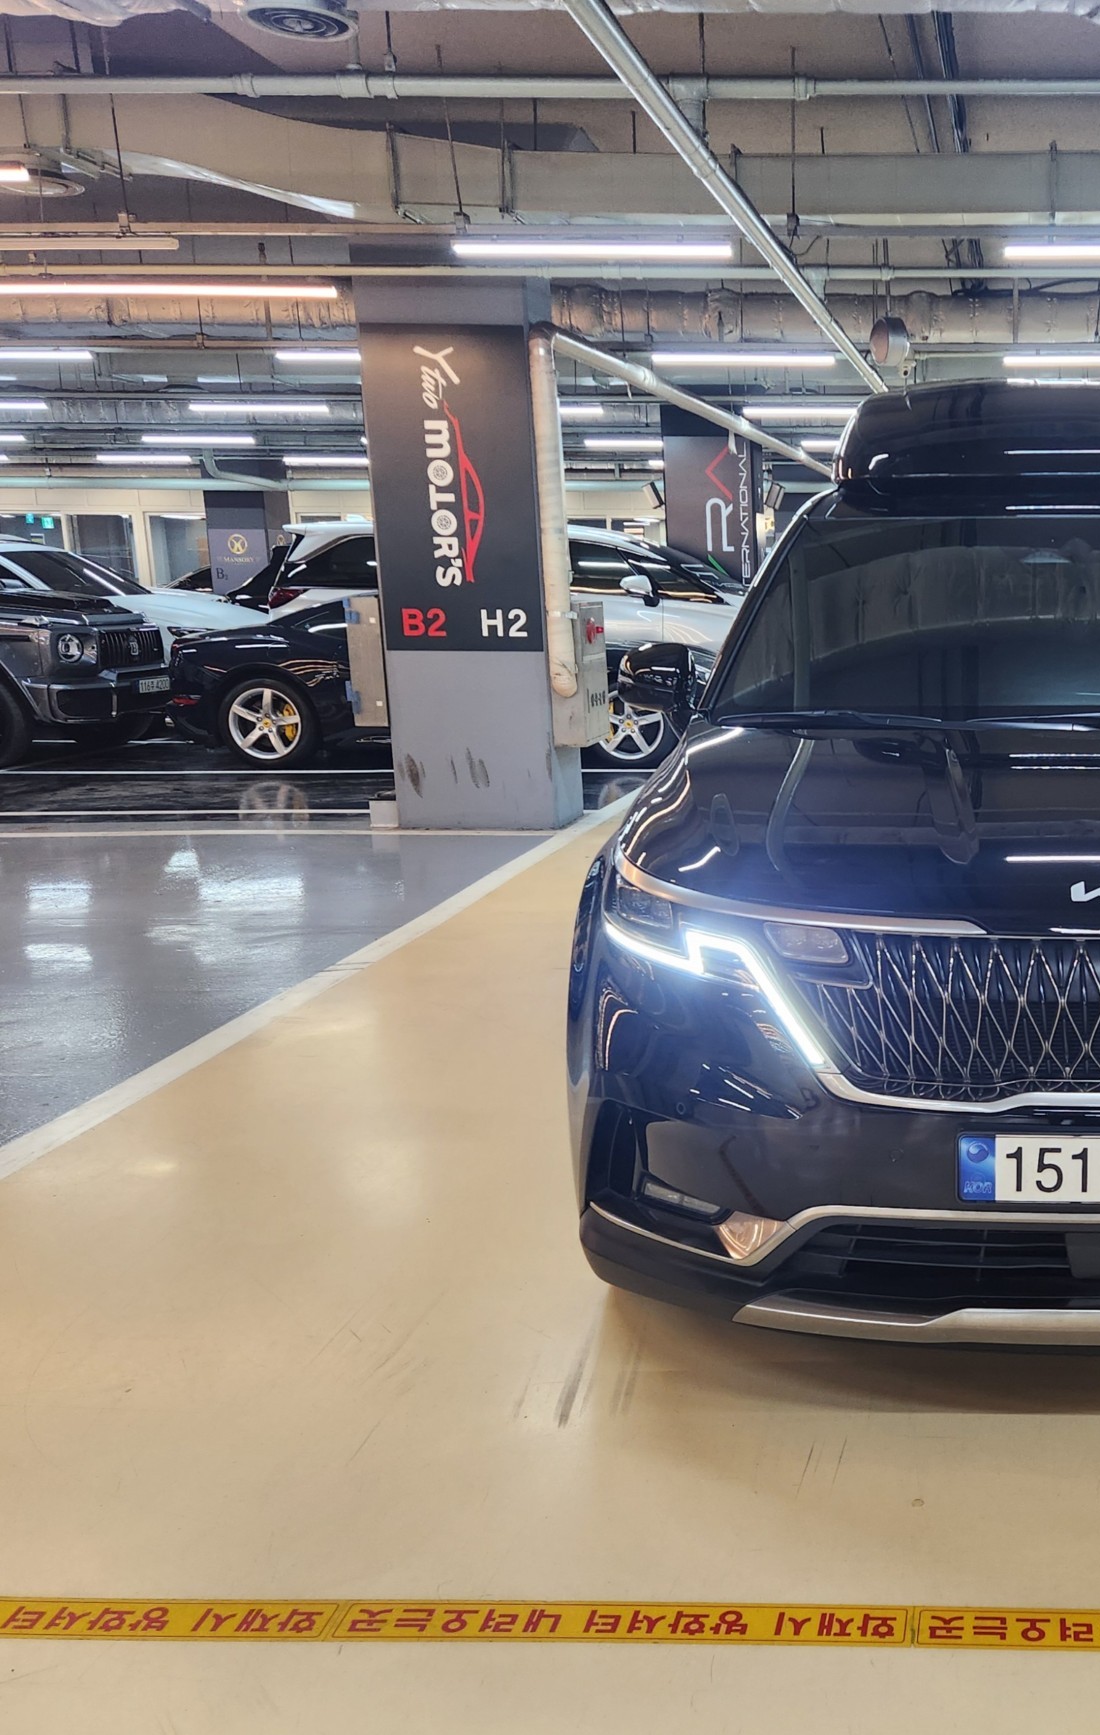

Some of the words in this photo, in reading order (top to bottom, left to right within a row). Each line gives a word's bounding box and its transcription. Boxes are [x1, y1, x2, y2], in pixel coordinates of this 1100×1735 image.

[401, 608, 447, 637] B2
[480, 608, 528, 638] H2
[0, 1606, 170, 1632] 방화셔터
[190, 1608, 324, 1634] 화재시
[582, 1610, 749, 1636] 방화셔터
[774, 1614, 899, 1639] 화재시
